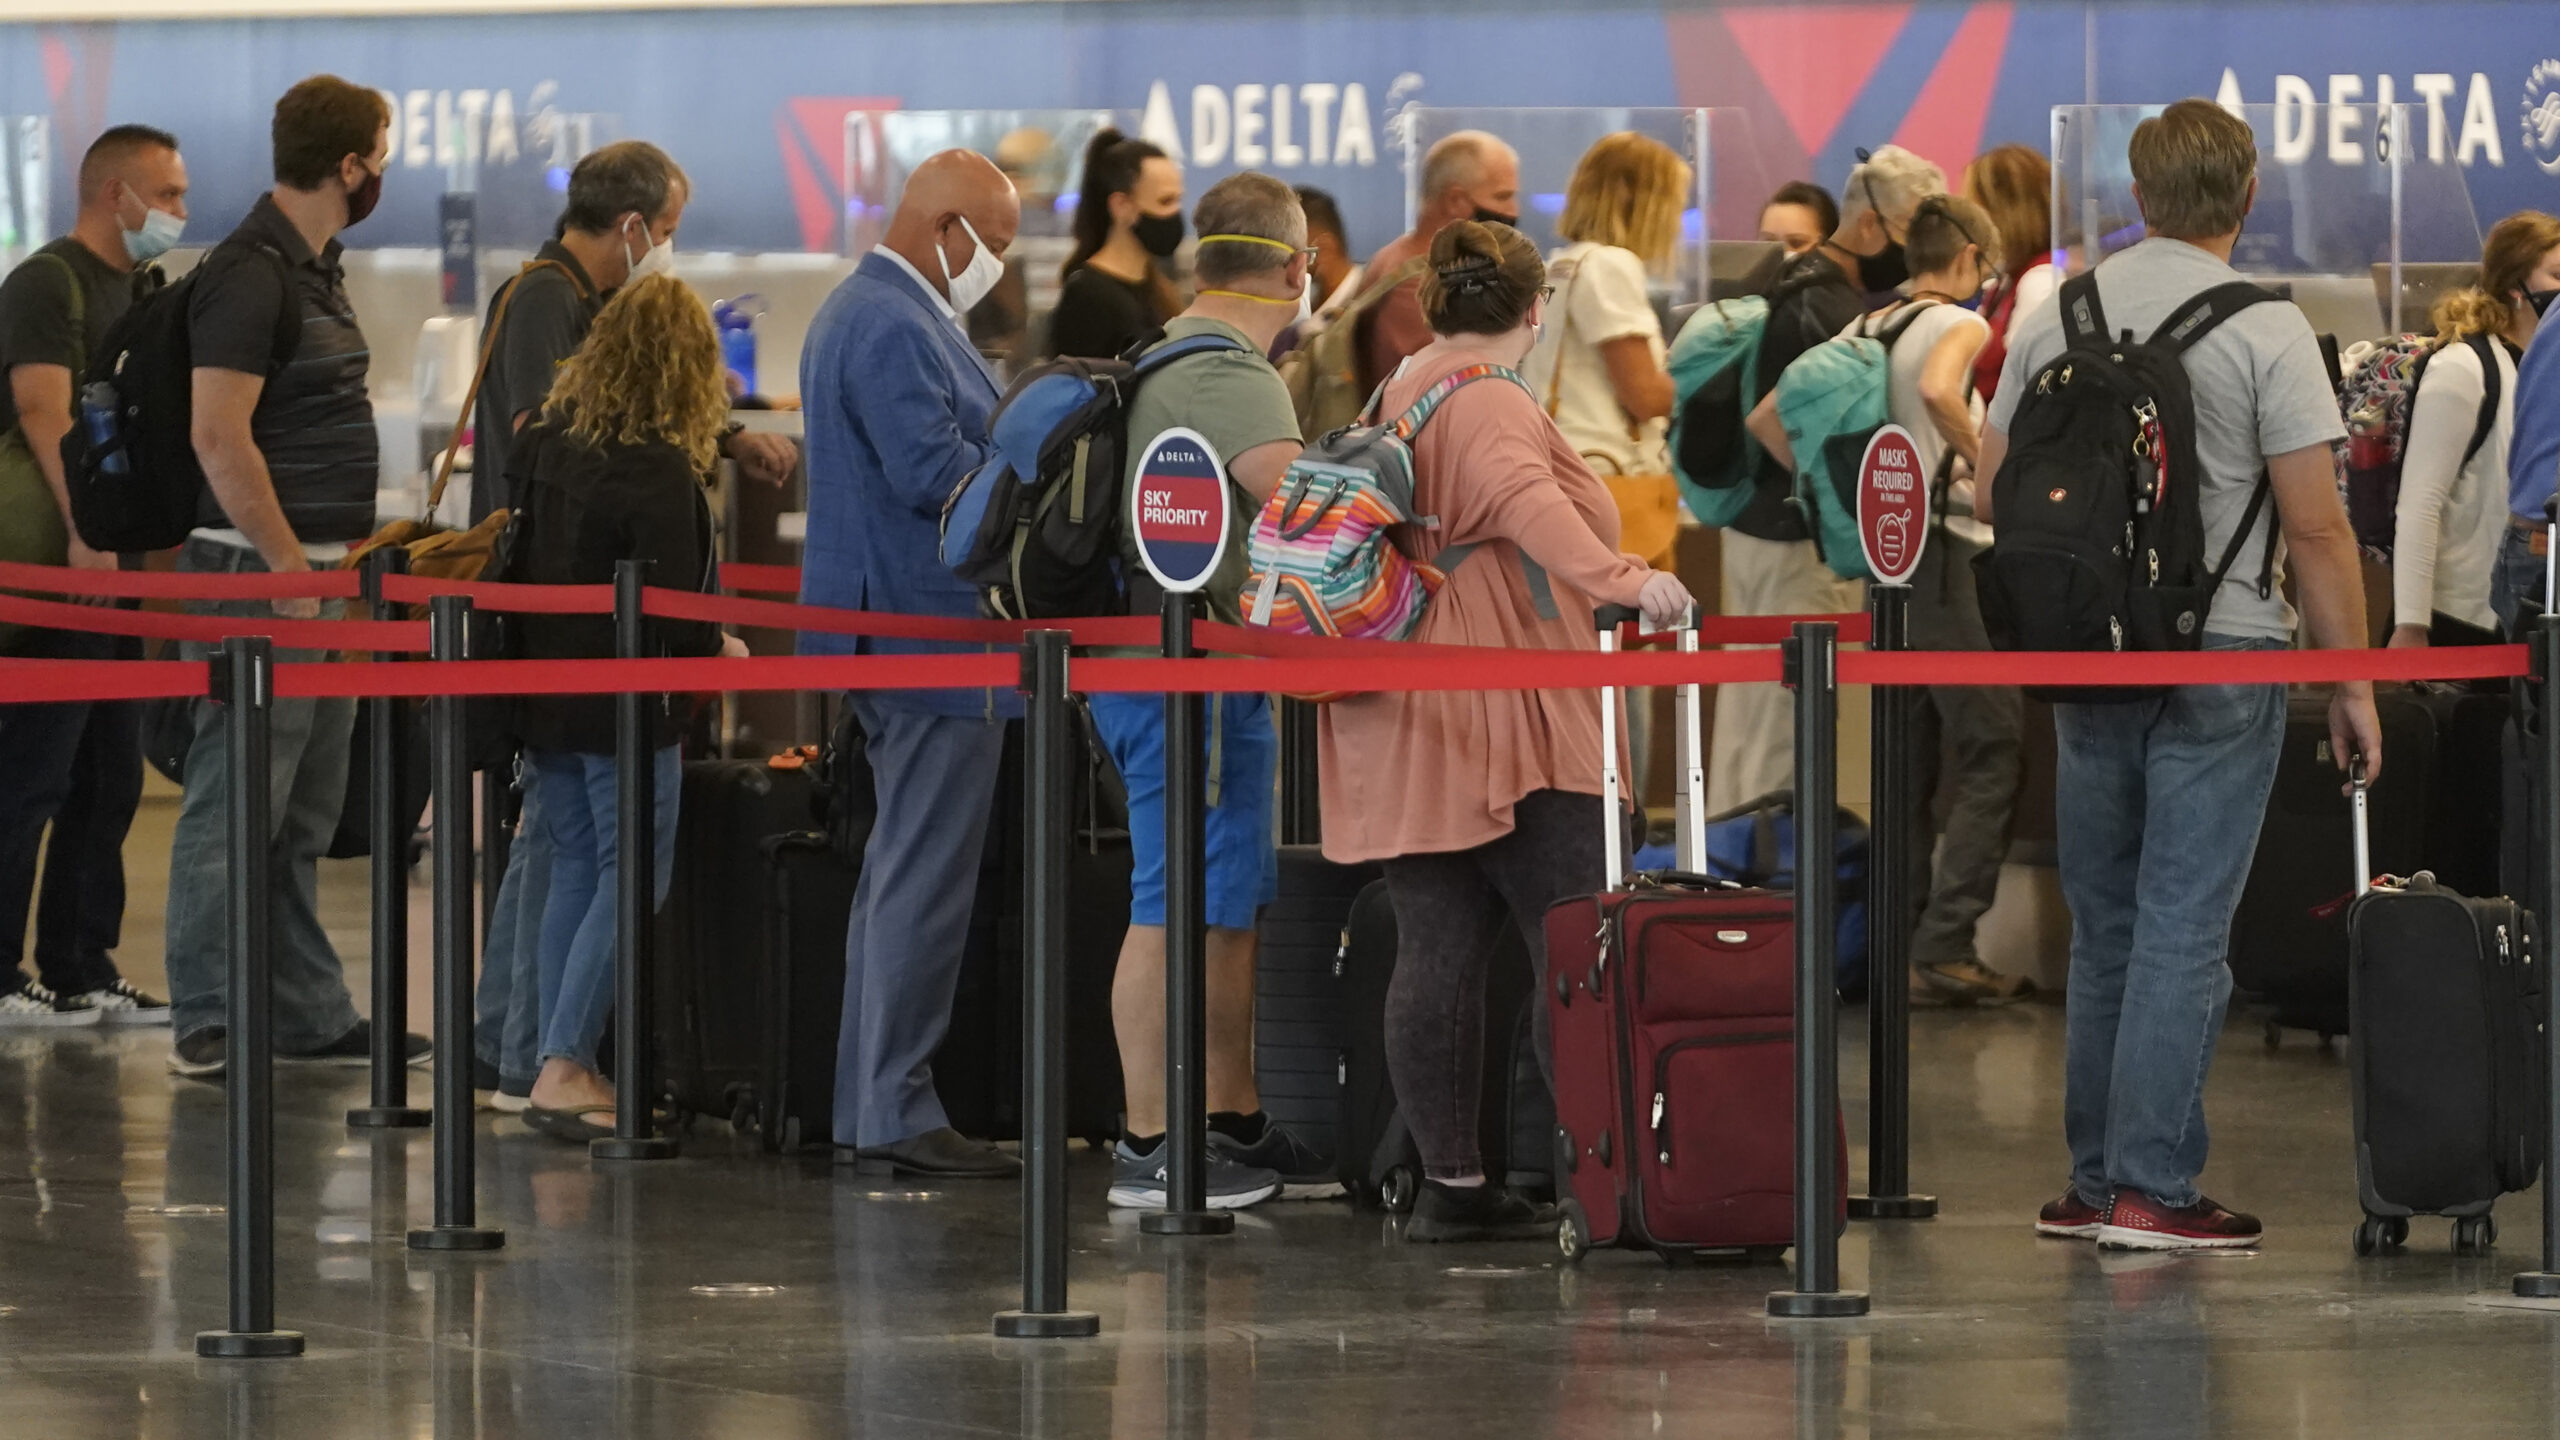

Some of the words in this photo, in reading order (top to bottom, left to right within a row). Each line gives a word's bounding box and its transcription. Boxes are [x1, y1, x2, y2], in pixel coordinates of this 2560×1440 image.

[1191, 82, 1376, 168] DELTA
[2375, 115, 2389, 163] 6
[1166, 451, 1195, 462] DELTA
[1879, 448, 1907, 468] MASKS
[1873, 470, 1913, 491] REQUIRED
[1143, 490, 1171, 506] SKY
[1143, 507, 1207, 526] PRIORITY
